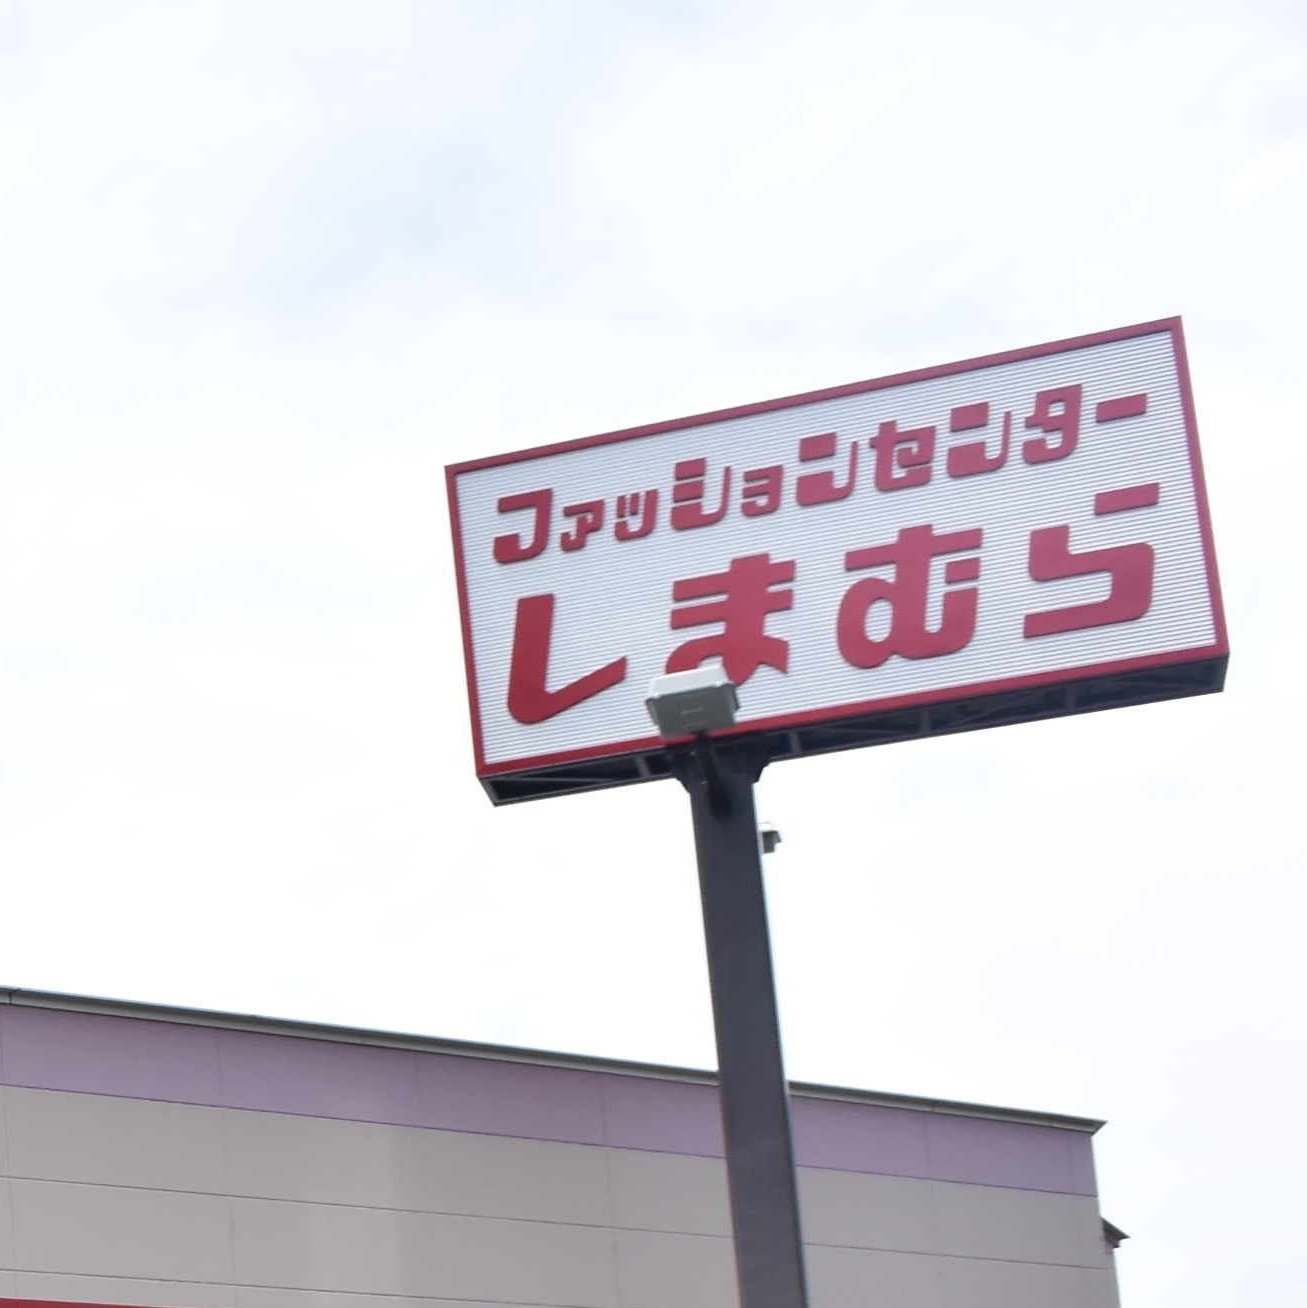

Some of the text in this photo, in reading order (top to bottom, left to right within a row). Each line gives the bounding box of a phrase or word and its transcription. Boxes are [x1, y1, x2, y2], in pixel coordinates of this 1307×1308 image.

[492, 383, 1149, 564] ファッションセンター
[506, 483, 1161, 725] しまむら
